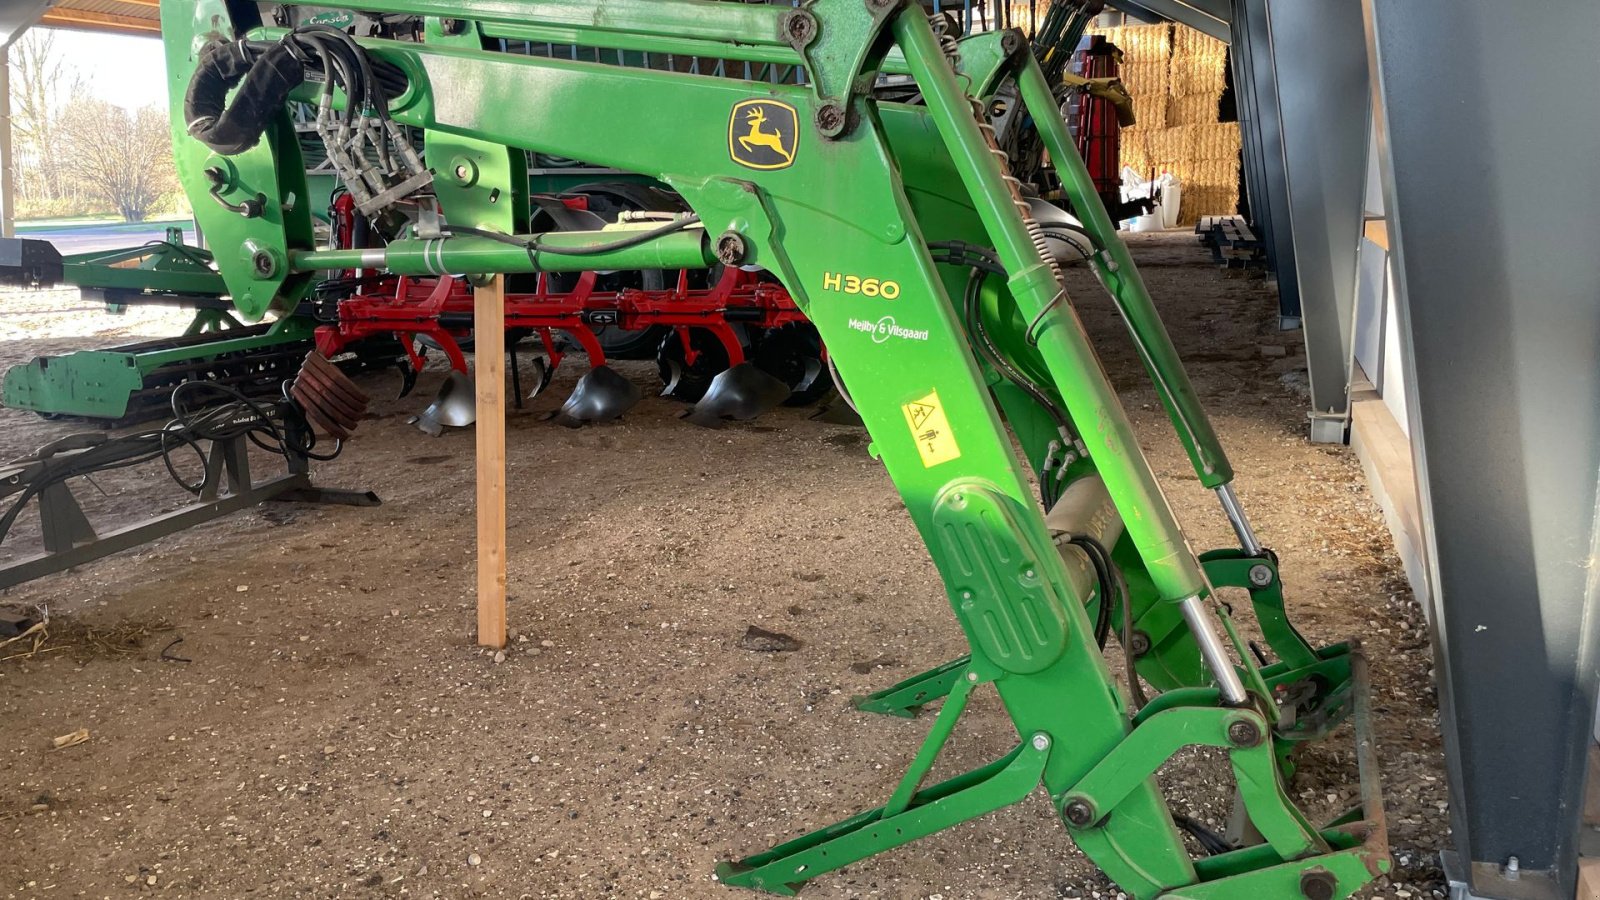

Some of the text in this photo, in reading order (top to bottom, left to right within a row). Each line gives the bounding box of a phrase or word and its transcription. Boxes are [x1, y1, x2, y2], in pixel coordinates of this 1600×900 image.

[848, 318, 928, 340] Mejlby & Vilsgaard
